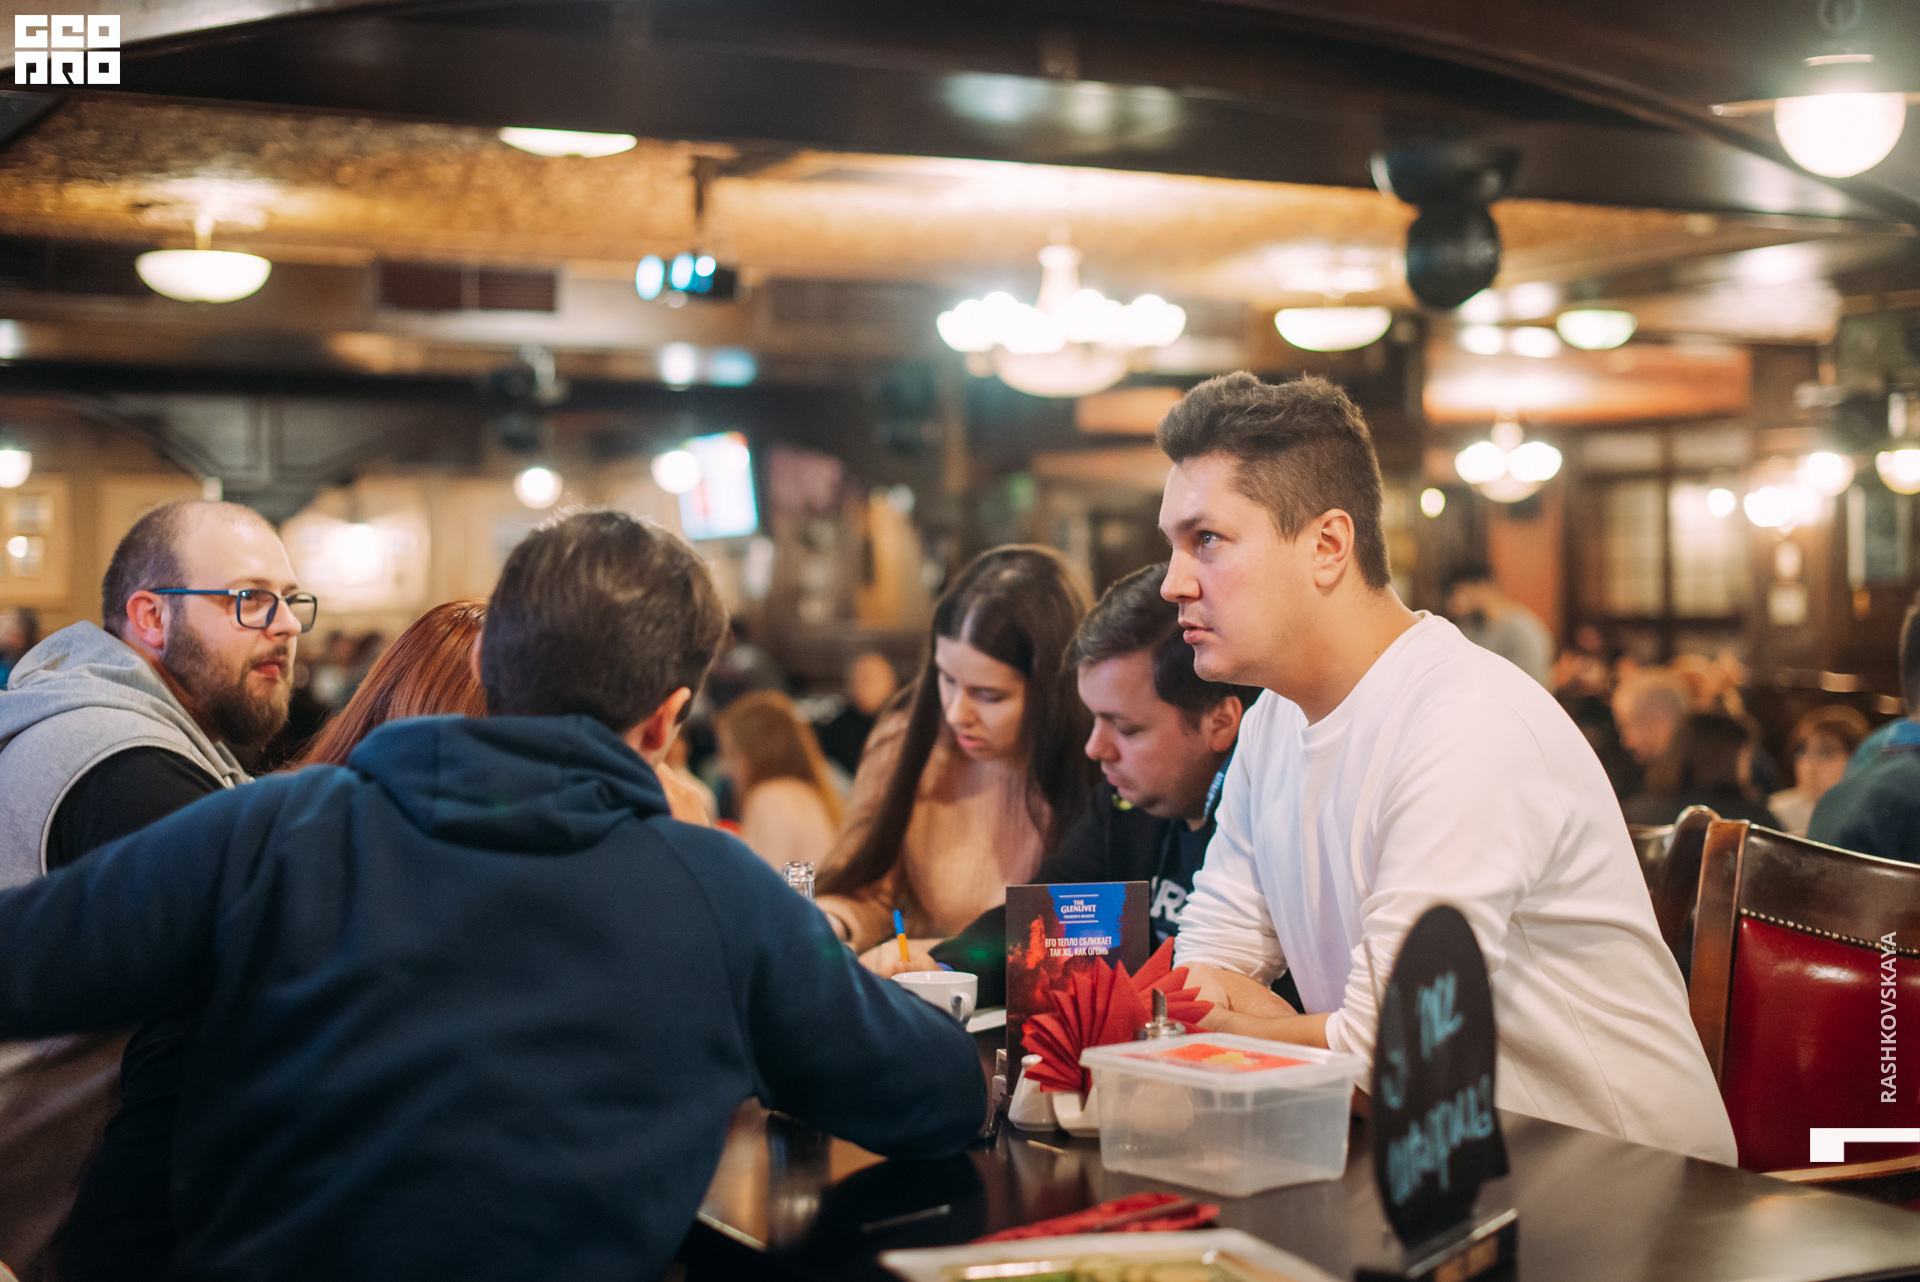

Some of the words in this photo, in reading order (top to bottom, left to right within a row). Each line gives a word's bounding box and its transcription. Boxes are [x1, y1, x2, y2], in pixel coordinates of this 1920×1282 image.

[1060, 904, 1097, 914] GLENLIVET
[1045, 938, 1057, 948] ЕГО
[1057, 937, 1078, 947] ТЕПЛО
[1079, 936, 1112, 946] СБЛИЖАЕТ
[1050, 948, 1062, 957] ТАК
[1074, 947, 1088, 956] КАК
[1087, 946, 1109, 956] ОГОНЬ
